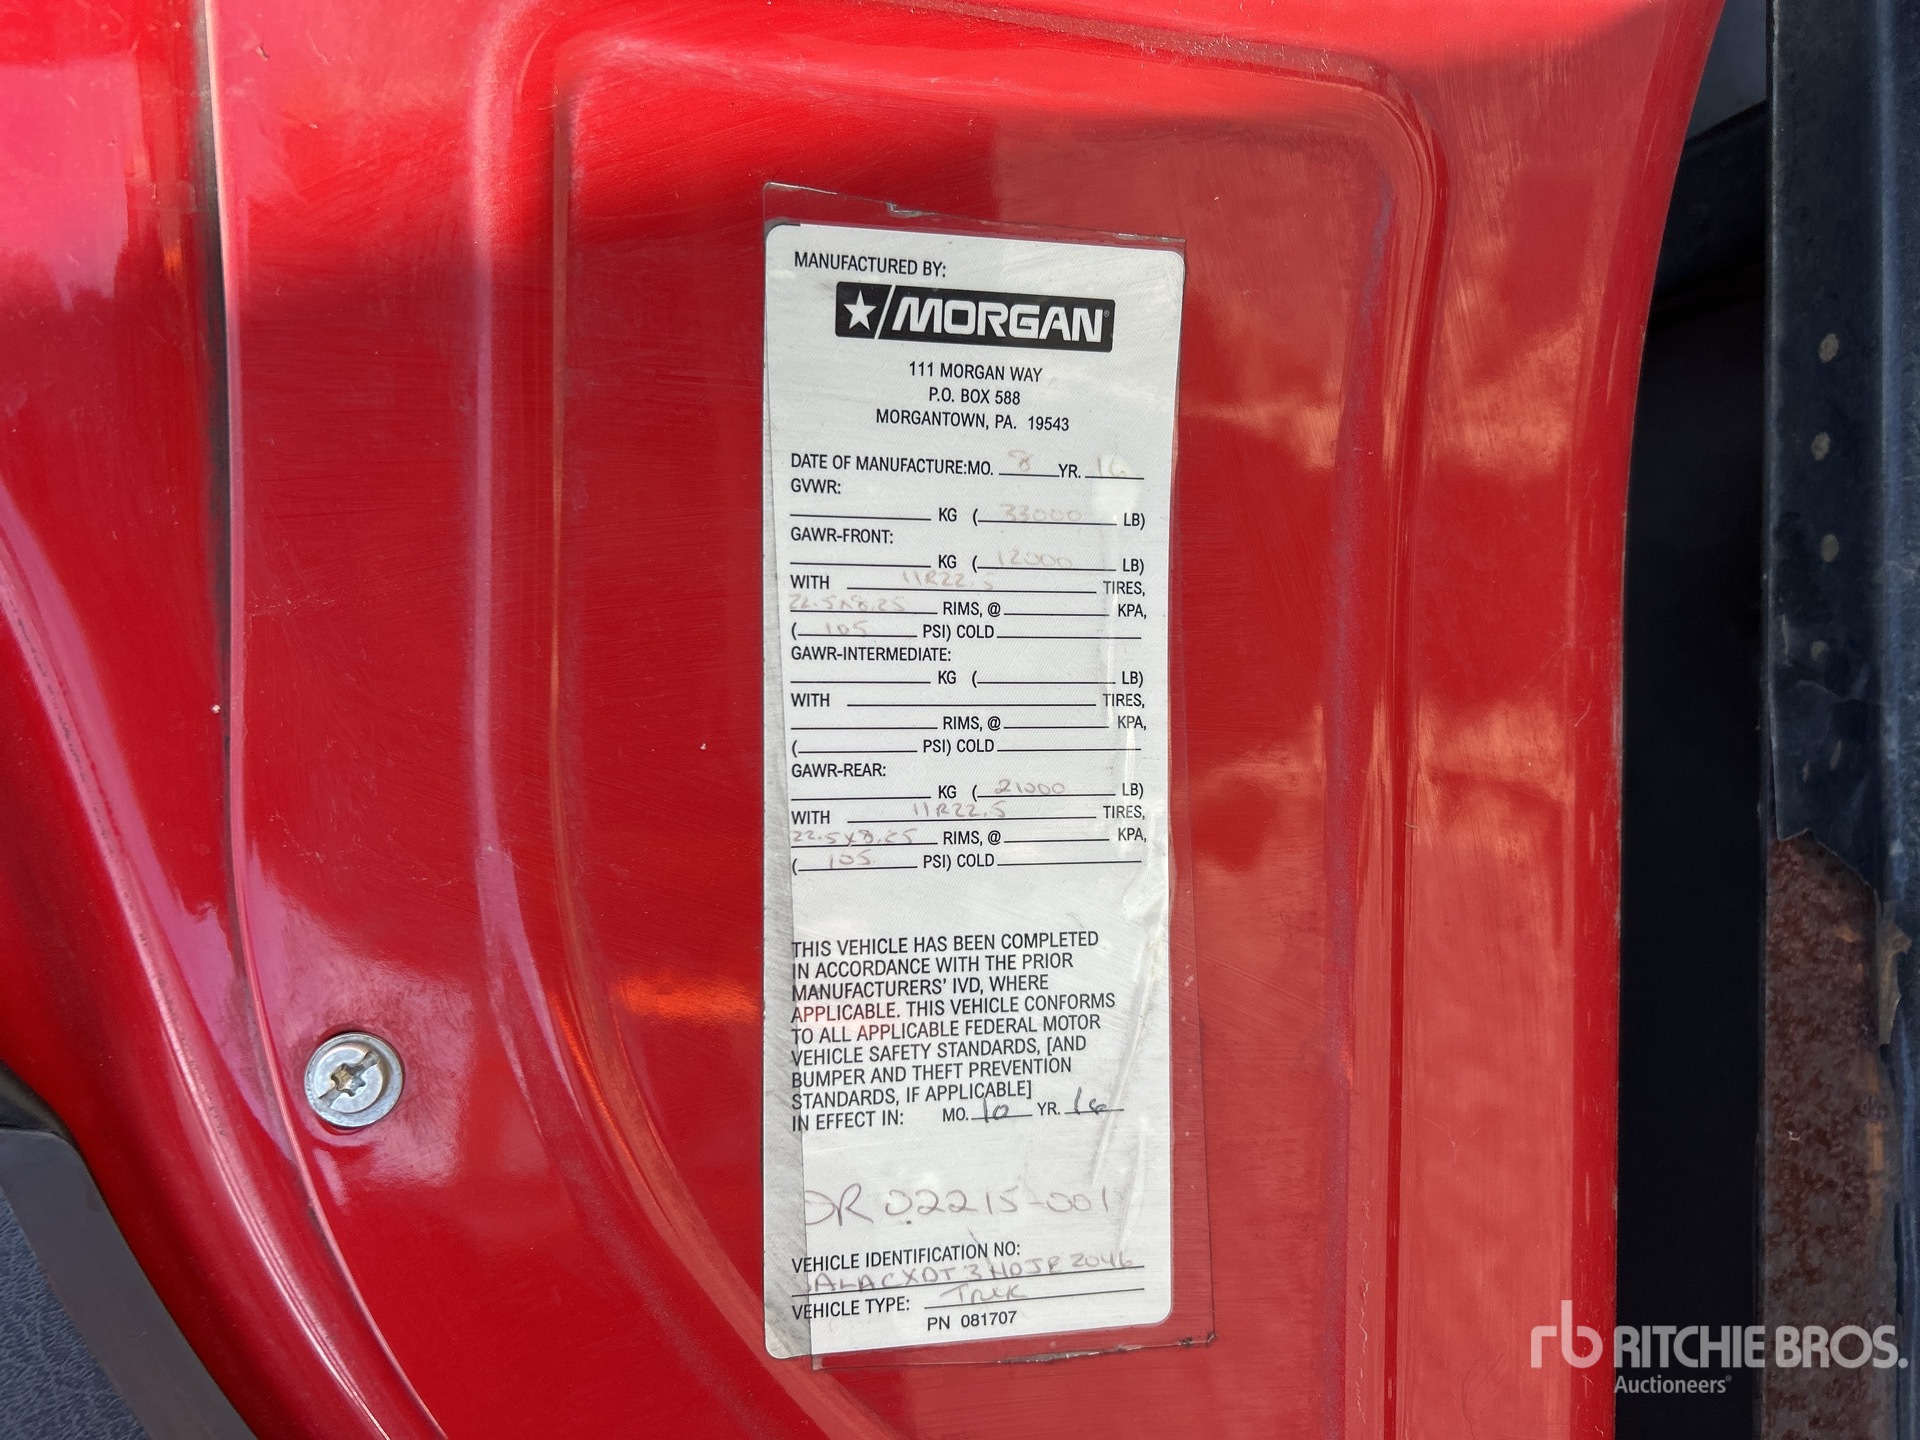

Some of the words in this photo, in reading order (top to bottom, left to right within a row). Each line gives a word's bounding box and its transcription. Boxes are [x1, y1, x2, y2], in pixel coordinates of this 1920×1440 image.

[794, 251, 918, 275] MANUFACTURED
[922, 260, 946, 278] BY:
[891, 296, 1103, 343] MORGAN
[909, 361, 934, 377] 111
[940, 363, 1005, 381] MORGAN
[1010, 366, 1042, 383] WAY
[928, 387, 955, 403] P.O.
[960, 388, 990, 404] BOX
[994, 390, 1020, 406] 588
[876, 409, 989, 430] MORGANTOWN,
[995, 414, 1017, 429] PA.
[1028, 416, 1069, 432] 19543
[790, 453, 828, 469] DATE
[832, 455, 851, 469] OF
[1058, 464, 1081, 479] YR.
[791, 478, 841, 494] GVWR:
[939, 508, 957, 522] KG
[1123, 512, 1145, 530] LB)
[791, 527, 894, 544] GAWR-FRONT:
[938, 555, 957, 569] KG
[1122, 559, 1144, 575] LB)
[790, 575, 829, 589] WITH
[1103, 581, 1145, 597] TIRES,
[943, 602, 983, 617] RIMS,
[1118, 604, 1147, 620] KPA,
[923, 625, 951, 642] PSI)
[957, 626, 994, 638] COLD
[791, 646, 951, 662] GAWR-INTERMEDIATE:
[938, 671, 957, 685] KG
[1122, 671, 1144, 688] LB)
[791, 693, 829, 707] WITH
[1102, 693, 1145, 709] TIRES,
[943, 717, 983, 732] RIMS,
[1118, 716, 1147, 731] KPA,
[923, 739, 951, 756] PSI)
[957, 739, 994, 752] COLD
[791, 763, 886, 778] GAWR-REAR:
[938, 785, 957, 799] KG
[1122, 782, 1144, 799] LB)
[791, 811, 829, 825] WITH
[1103, 805, 1145, 821] TIRES,
[943, 831, 983, 846] RIMS,
[1118, 828, 1147, 843] KPA,
[923, 855, 951, 871] PSI)
[957, 854, 994, 868] COLD
[792, 941, 831, 958] THIS
[838, 938, 908, 956] VEHICLE
[914, 936, 947, 953] HAS
[953, 934, 995, 952] BEEN
[1001, 931, 1099, 950] COMPLETED
[792, 963, 809, 979] IN
[815, 958, 930, 979] ACCORDANCE
[936, 956, 979, 973] WITH
[985, 954, 1017, 971] THE
[1022, 953, 1073, 969] PRIOR
[953, 978, 984, 997] IVD,
[990, 975, 1048, 992] WHERE
[791, 1002, 900, 1023] APPLICABLE.
[906, 1000, 945, 1018] THIS
[950, 997, 1019, 1015] VEHICLE
[1024, 993, 1116, 1012] CONFORMS
[792, 1028, 813, 1044] TO
[819, 1026, 851, 1043] ALL
[857, 1020, 959, 1041] APPLICABLE
[965, 1016, 1037, 1035] FEDERAL
[1043, 1014, 1101, 1031] MOTOR
[791, 1048, 863, 1066] VEHICLE
[869, 1043, 931, 1062] SAFETY
[937, 1038, 1041, 1059] STANDARDS,
[792, 1068, 865, 1088] BUMPER
[870, 1066, 906, 1084] AND
[912, 1063, 963, 1081] THEFT
[969, 1057, 1072, 1078] PREVENTION
[792, 1089, 900, 1110] STANDARDS,
[906, 1088, 920, 1102] IF
[792, 1116, 809, 1131] IN
[816, 1111, 875, 1129] EFFECT
[882, 1111, 904, 1126] IN:
[942, 1108, 969, 1122] MO.
[1038, 1102, 1061, 1116] YR.
[792, 1252, 860, 1273] VEHICLE
[866, 1244, 989, 1268] IDENTIFICATION
[994, 1241, 1021, 1256] NO:
[792, 1299, 860, 1320] VEHICLE
[865, 1297, 910, 1314] TYPE:
[928, 1316, 950, 1331] PN
[961, 1311, 1017, 1328] 081707
